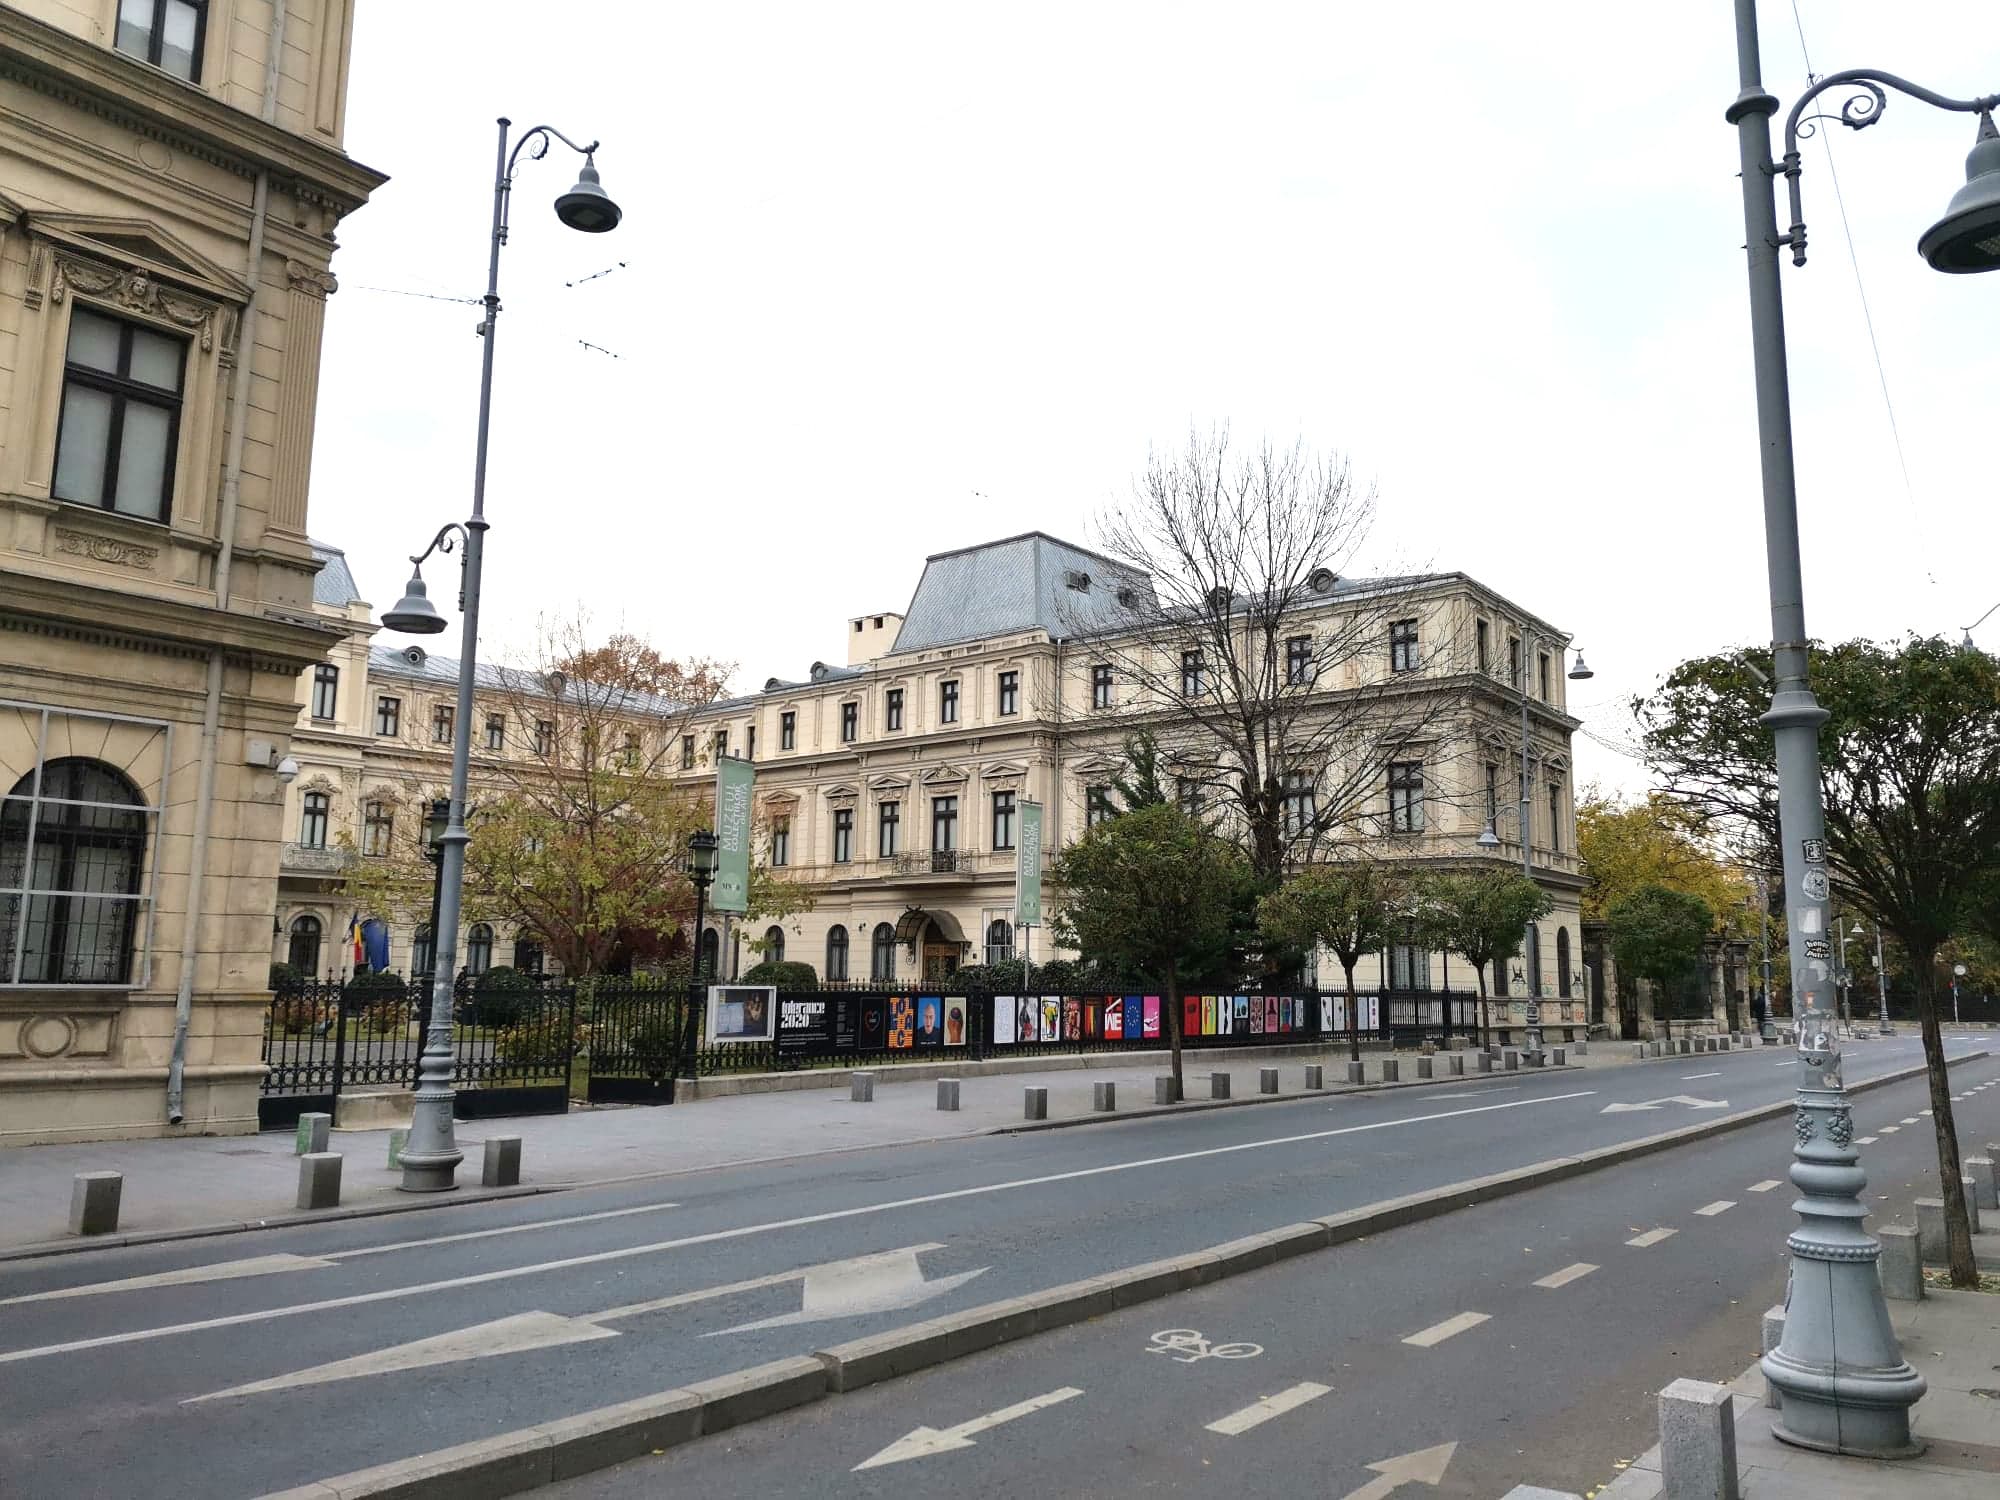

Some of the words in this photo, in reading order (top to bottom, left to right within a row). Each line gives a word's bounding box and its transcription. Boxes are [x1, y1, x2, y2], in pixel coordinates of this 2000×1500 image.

[722, 783, 736, 850] MUZEUL
[781, 1014, 809, 1029] 2020
[1105, 1012, 1122, 1031] WE
